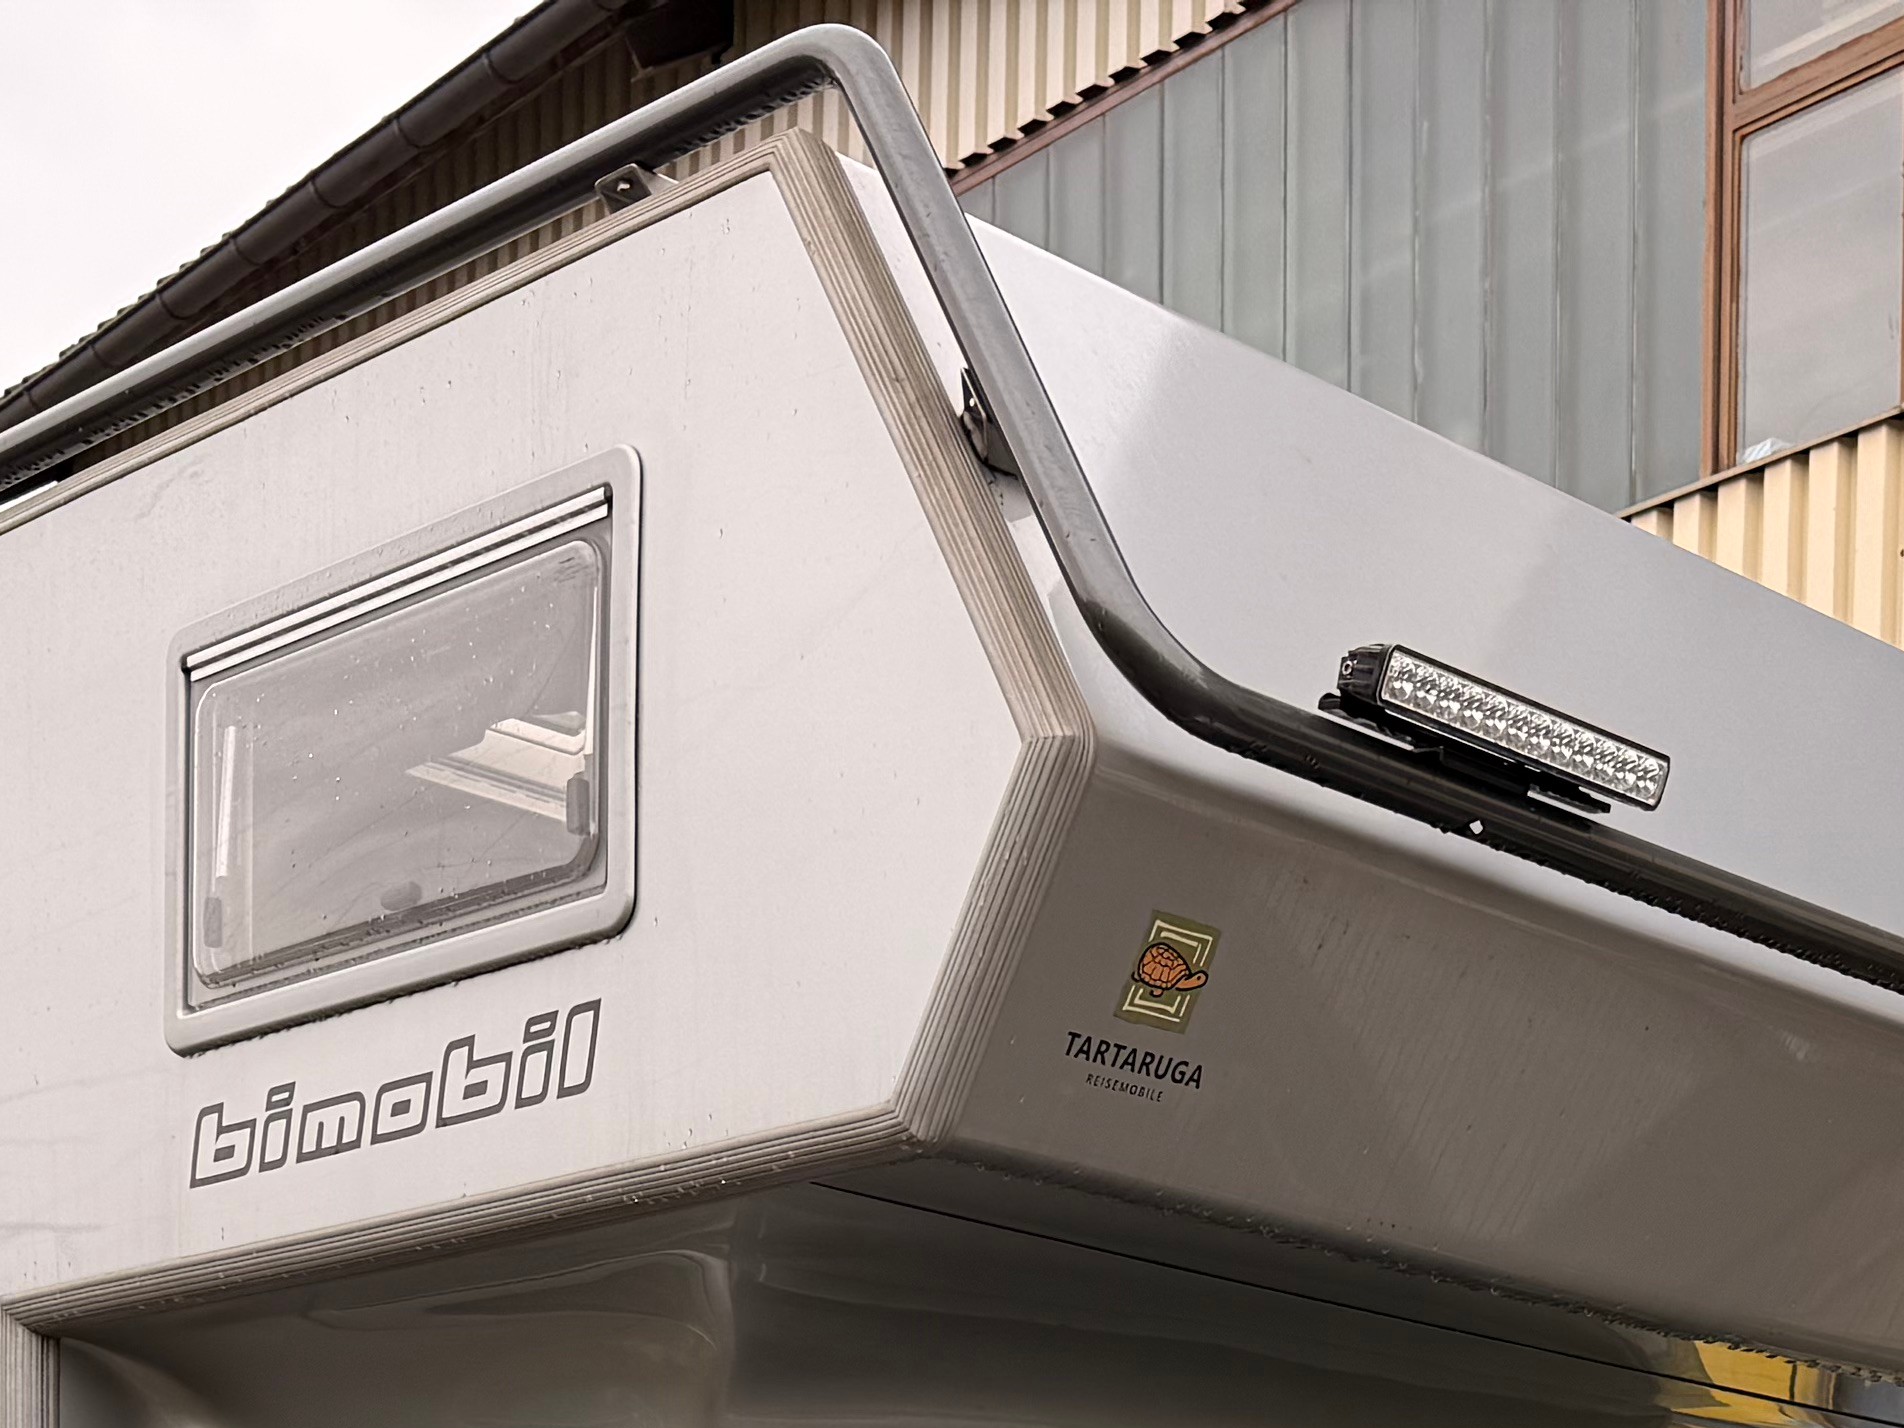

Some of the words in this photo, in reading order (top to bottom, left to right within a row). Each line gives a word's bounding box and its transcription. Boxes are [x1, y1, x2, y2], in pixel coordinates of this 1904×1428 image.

[1064, 1030, 1203, 1090] TARTARUGA
[1085, 1072, 1163, 1103] REISEMOBILE
[189, 997, 602, 1189] bimobil
